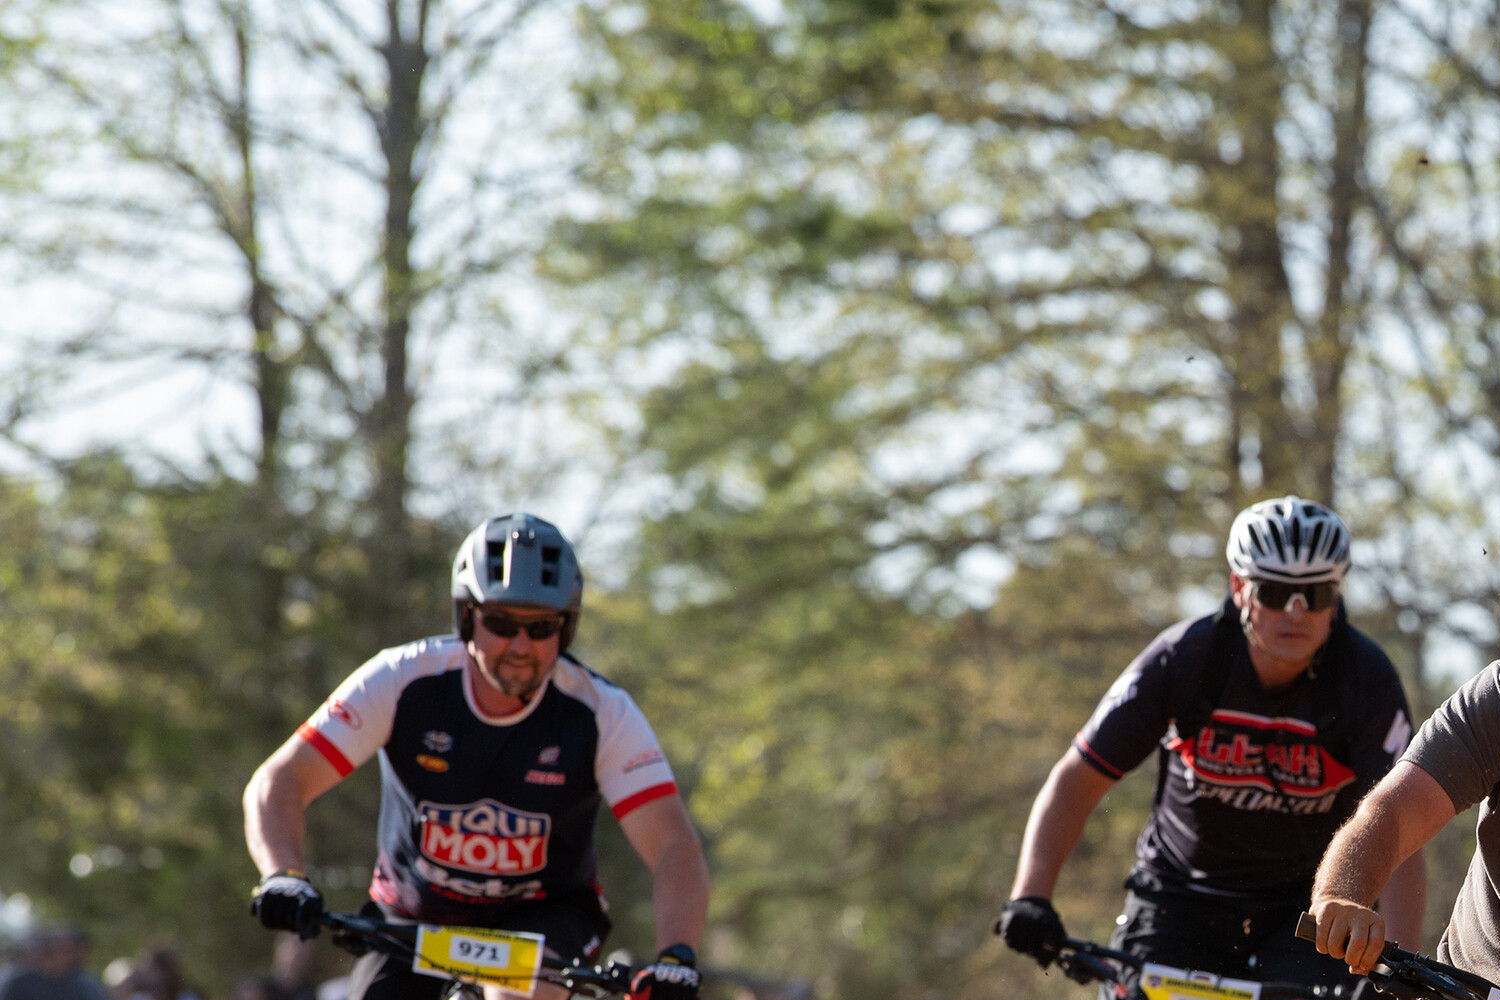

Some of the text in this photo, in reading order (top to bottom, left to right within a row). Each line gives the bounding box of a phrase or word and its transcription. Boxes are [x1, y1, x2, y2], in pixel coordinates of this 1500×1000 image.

[426, 805, 543, 838] LIQUI
[427, 824, 542, 870] MOLY
[458, 940, 499, 961] 971
